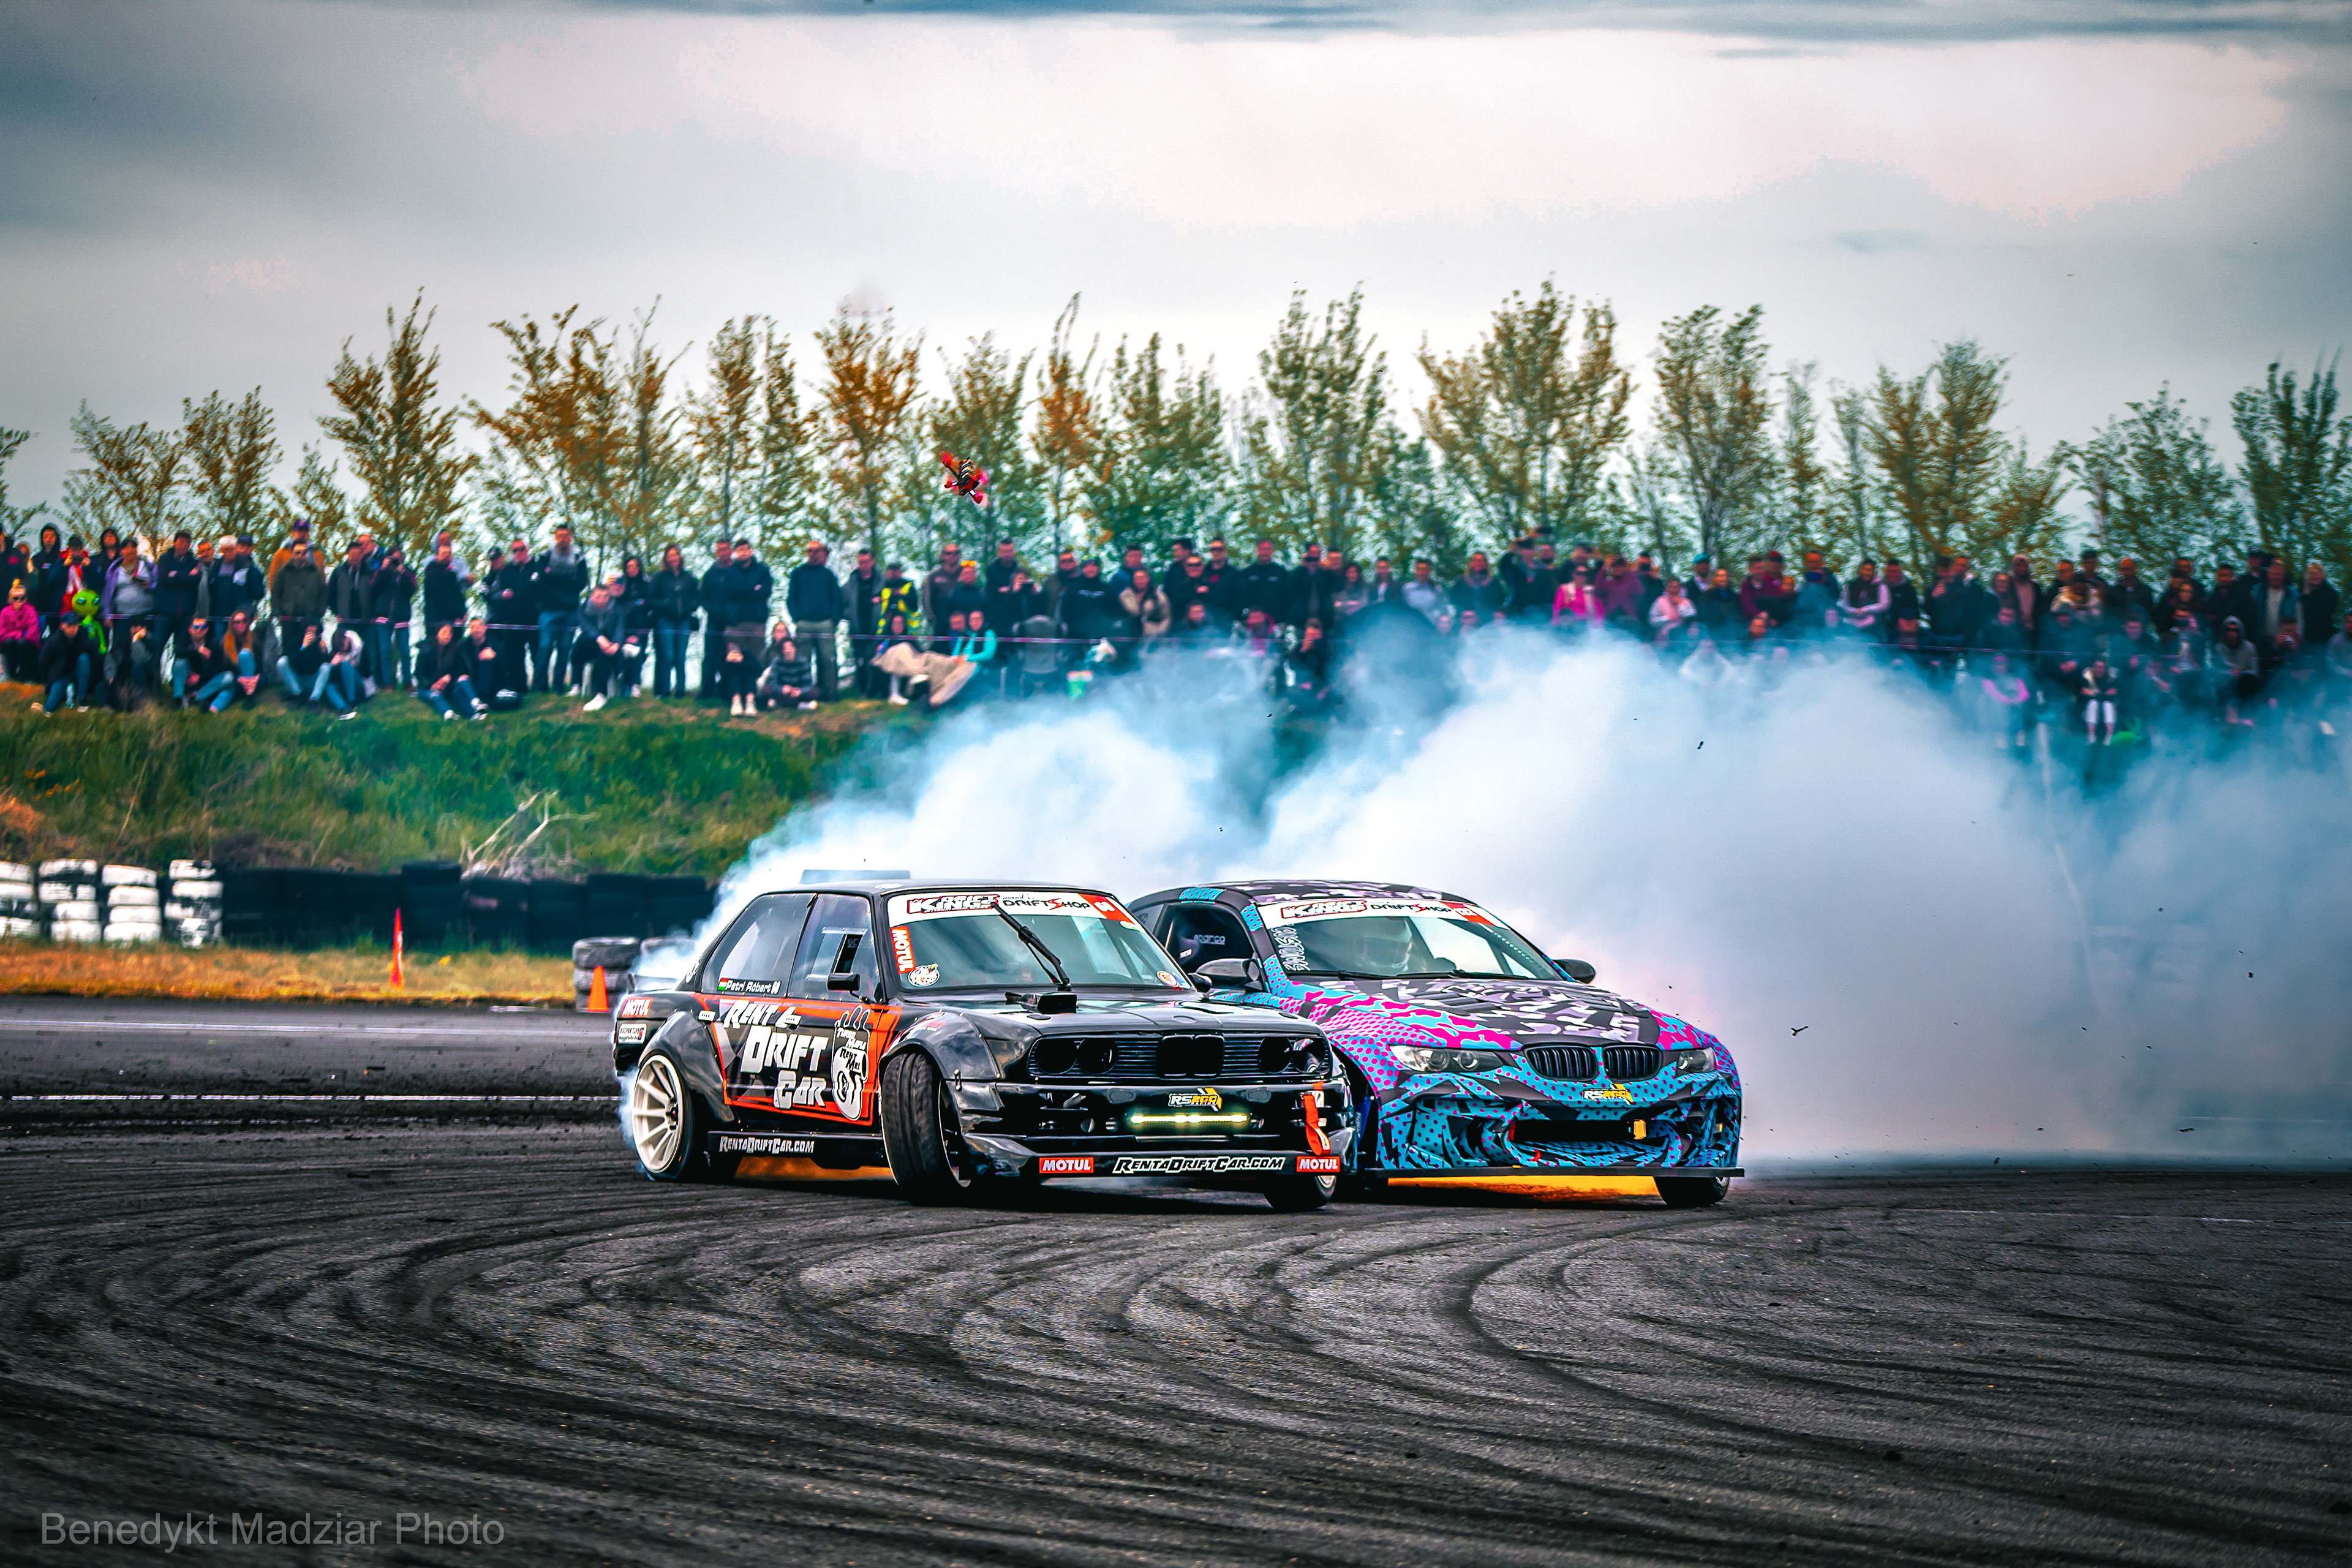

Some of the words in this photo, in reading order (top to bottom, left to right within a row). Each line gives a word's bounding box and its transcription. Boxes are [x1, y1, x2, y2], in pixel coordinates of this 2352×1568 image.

[892, 929, 914, 972] MOTUL
[1194, 934, 1226, 944] sparco
[622, 999, 651, 1016] MOTUL
[723, 1000, 780, 1029] RENT
[741, 1025, 829, 1074] DRIFT
[774, 1069, 827, 1110] CAR
[1042, 1159, 1091, 1171] MOTUL
[1299, 1158, 1338, 1170] MOTUL
